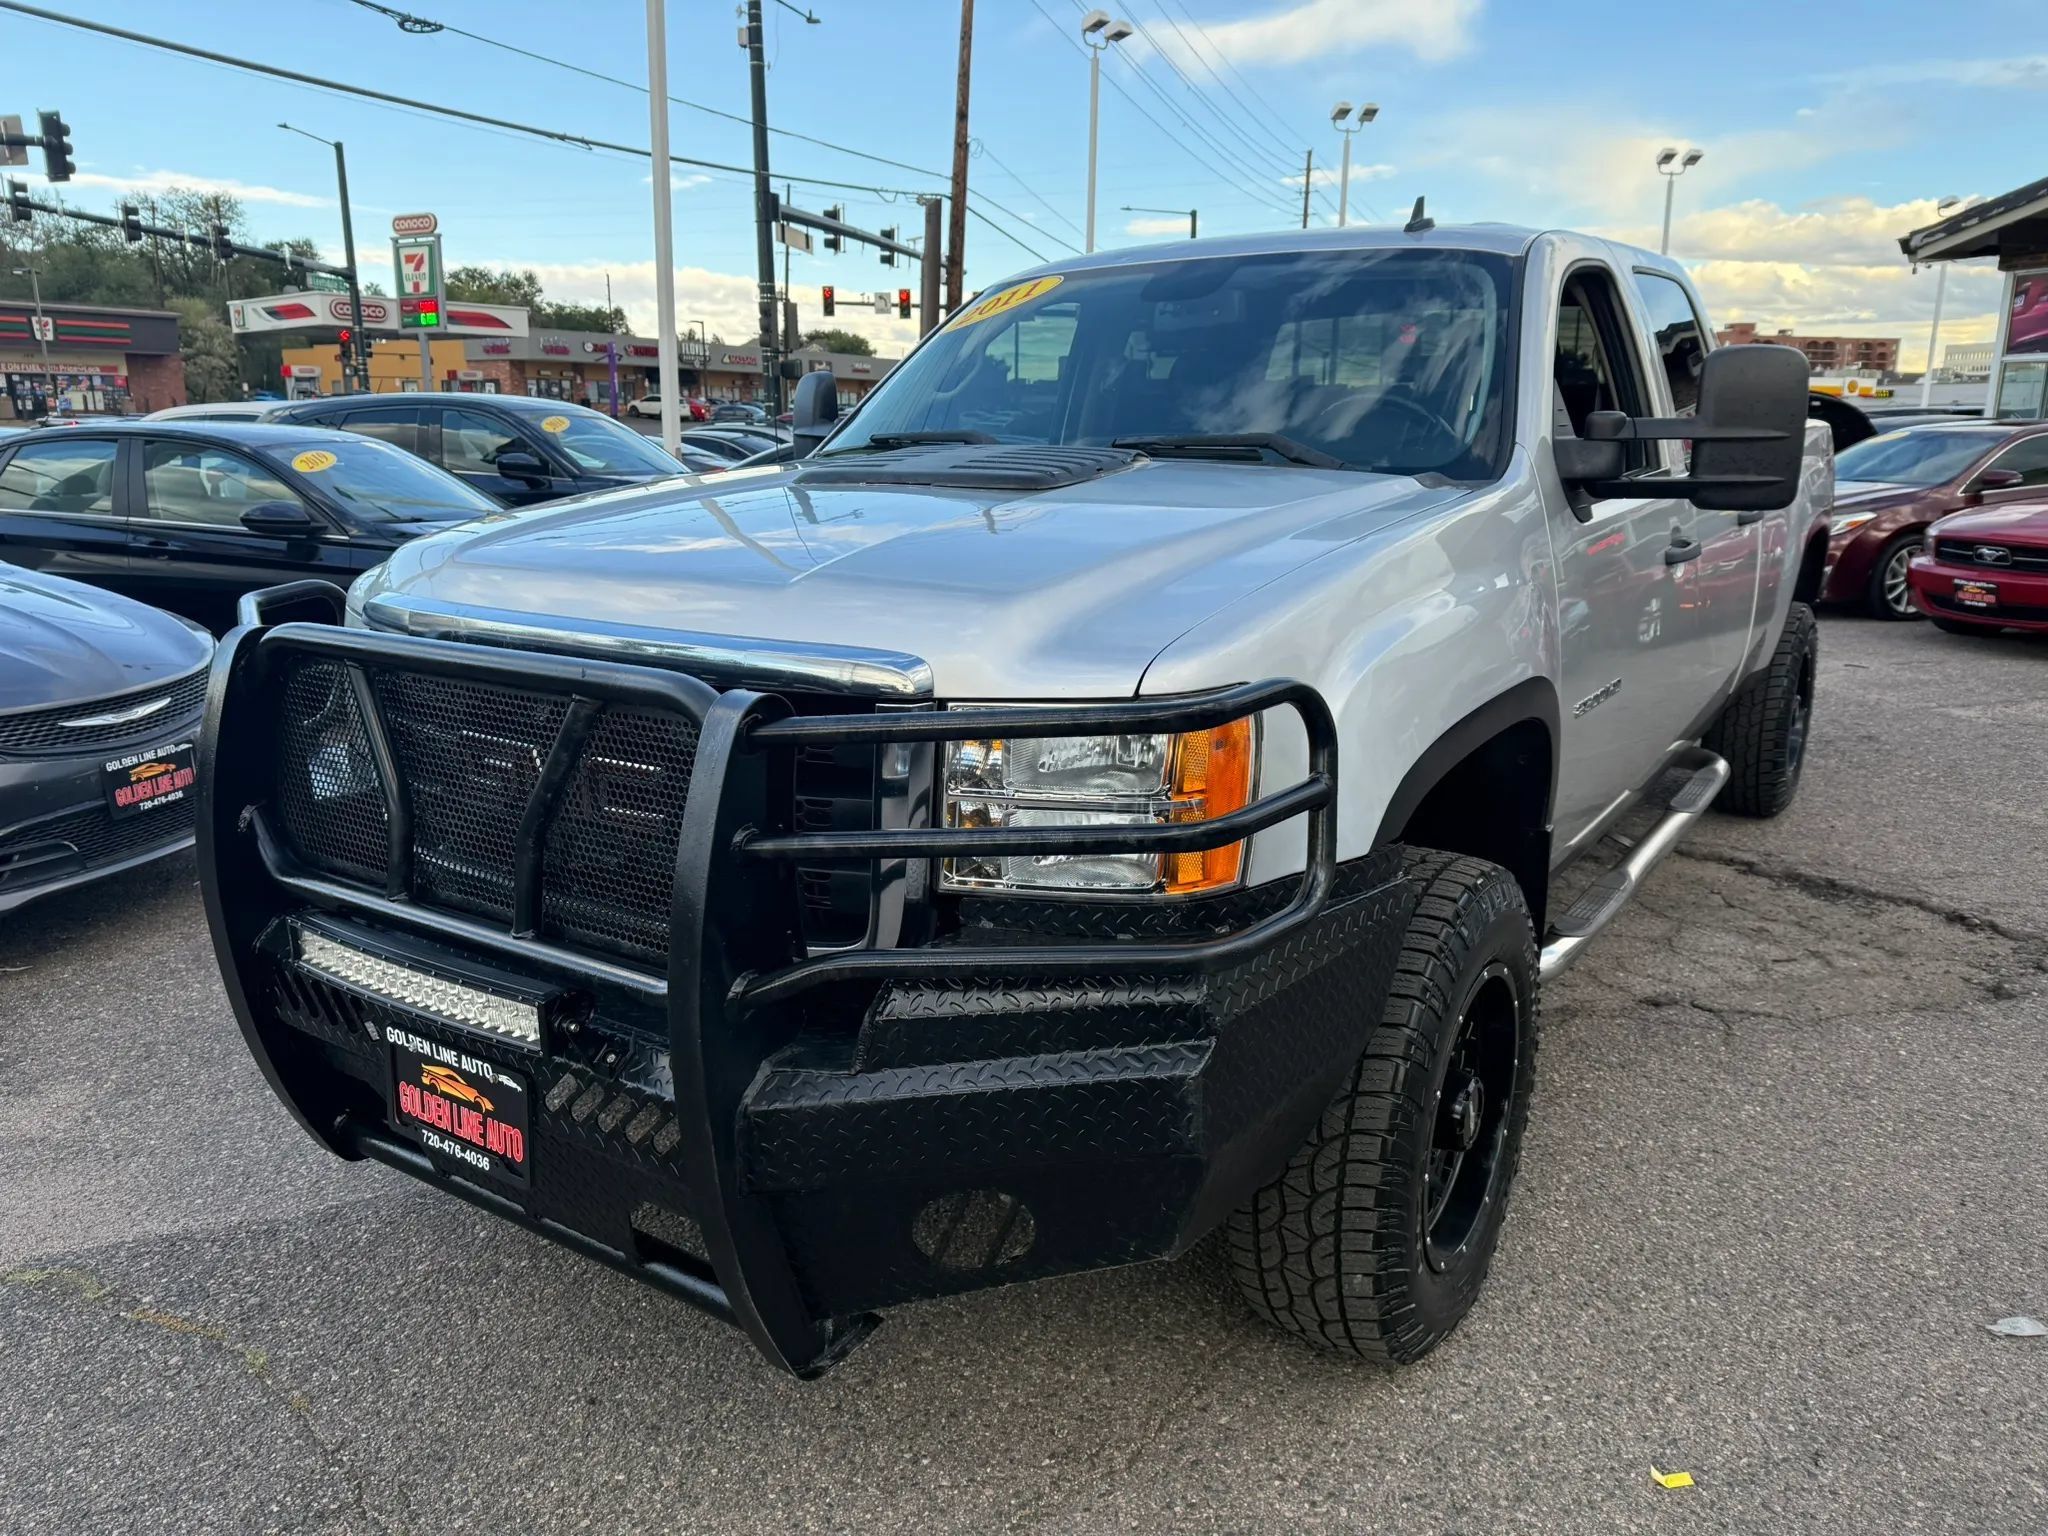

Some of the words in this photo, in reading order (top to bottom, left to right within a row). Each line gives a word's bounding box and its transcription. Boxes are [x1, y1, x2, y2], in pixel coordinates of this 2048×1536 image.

[955, 280, 1043, 326] 2011
[300, 452, 328, 470] 2019
[105, 754, 138, 771] GOLDEN
[139, 750, 156, 762] LINE
[156, 744, 176, 757] AUTO
[115, 780, 153, 807] GOLDEN
[153, 773, 174, 796] LINE
[173, 767, 194, 789] AUTO
[139, 790, 184, 811] 720-476-4036
[386, 1026, 432, 1057] GOLDEN
[432, 1043, 459, 1067] LINE
[461, 1055, 493, 1079] AUTO
[399, 1081, 452, 1132] GOLDEN
[452, 1102, 484, 1145] LINE
[486, 1117, 524, 1162] AUTO
[422, 1129, 490, 1171] 720-476-4036
